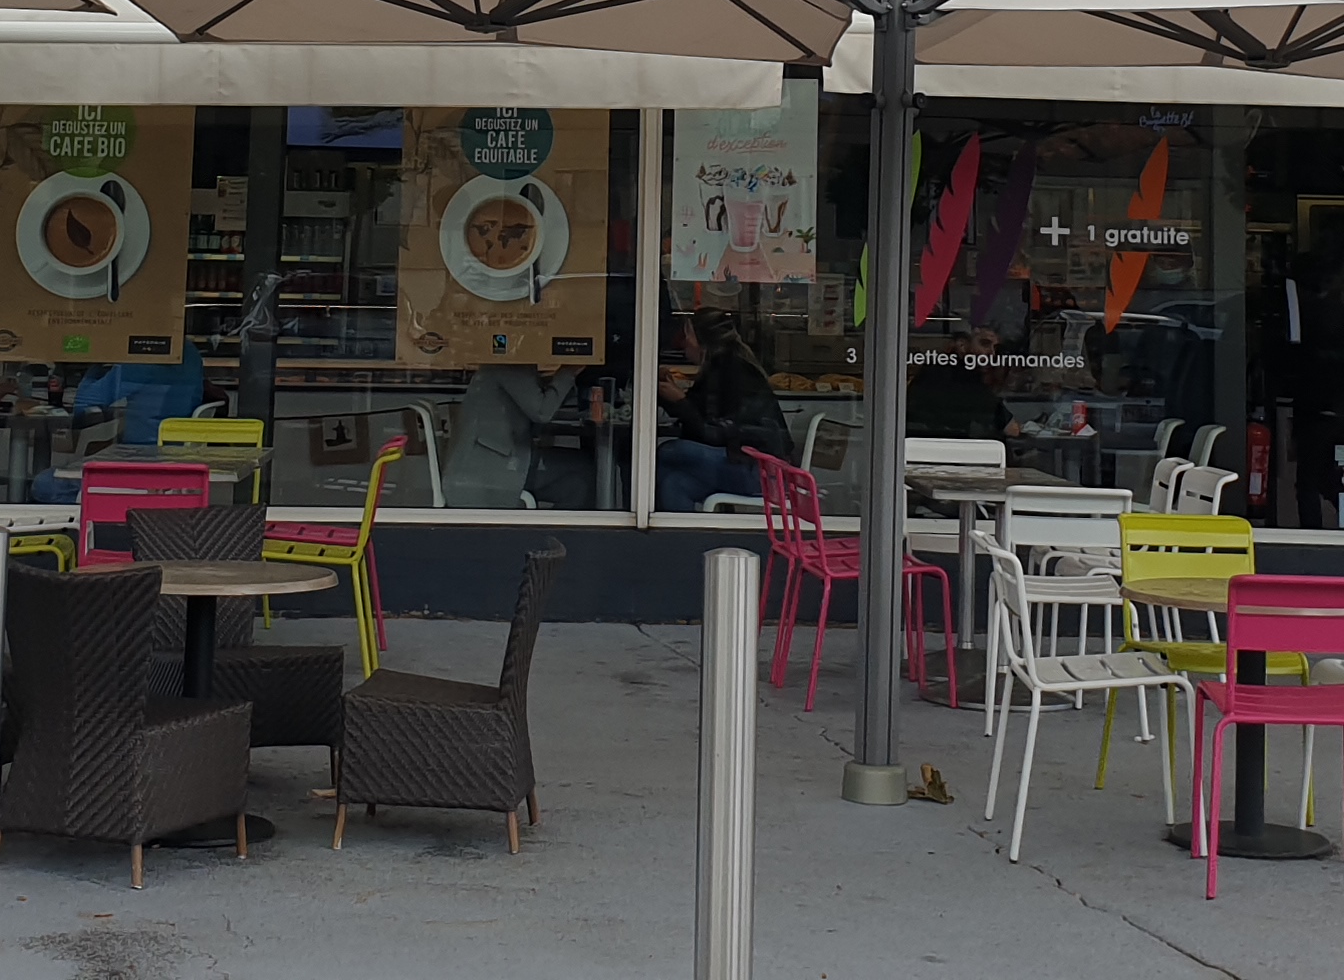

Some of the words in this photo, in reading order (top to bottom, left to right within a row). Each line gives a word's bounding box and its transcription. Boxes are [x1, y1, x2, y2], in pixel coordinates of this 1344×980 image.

[78, 105, 102, 121] ICI
[496, 107, 518, 118] ICI
[110, 122, 126, 135] UN
[525, 119, 538, 131] UN
[49, 136, 93, 157] CAFE
[97, 137, 126, 158] BIO
[487, 131, 526, 148] CAFE
[475, 148, 538, 164] EQUITABLE
[1087, 225, 1096, 241] 1
[1105, 226, 1190, 247] gratuite
[846, 347, 857, 364] 3
[964, 352, 1085, 370] gourmandes
